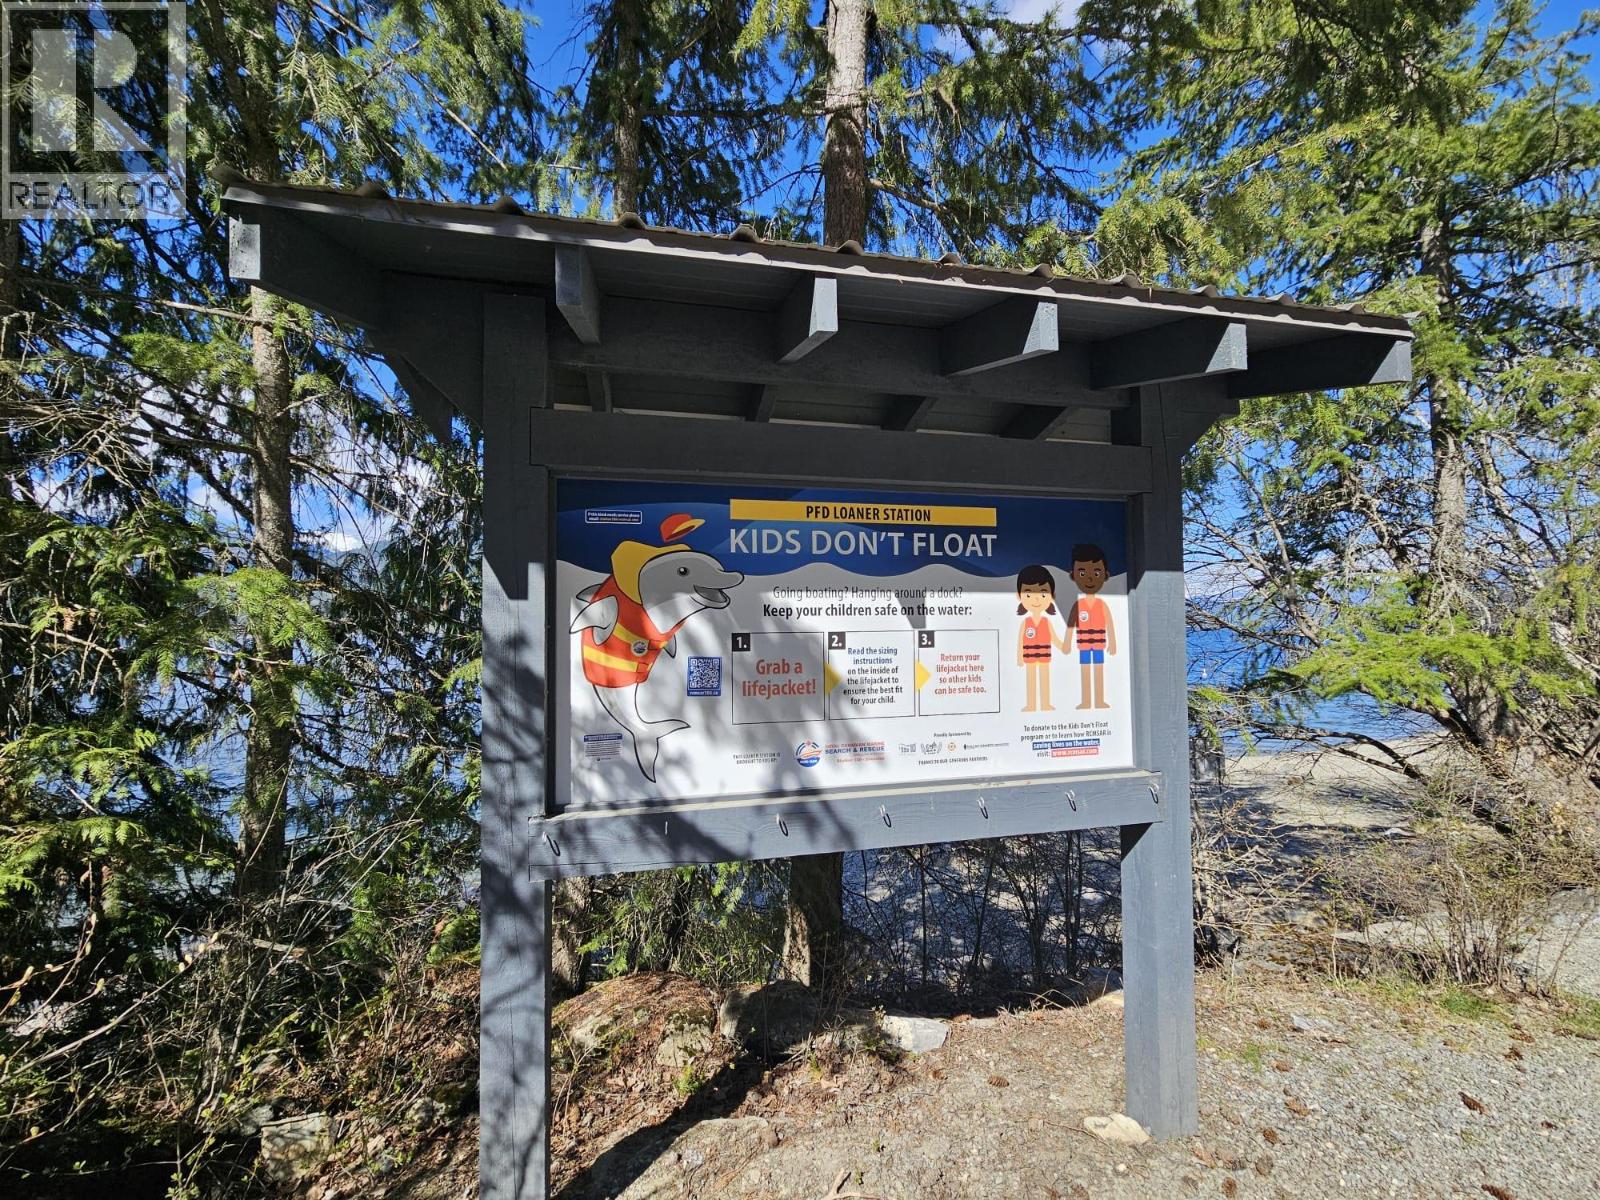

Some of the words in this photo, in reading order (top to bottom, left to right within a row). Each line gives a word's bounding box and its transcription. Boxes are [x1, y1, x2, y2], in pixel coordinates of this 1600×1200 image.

[806, 505, 830, 519] PFD
[833, 506, 880, 520] LOANER
[883, 508, 931, 522] STATION
[730, 528, 801, 554] KIDS
[811, 530, 905, 556] DON'T
[913, 532, 997, 557] FLOAT
[773, 586, 803, 601] Going
[805, 586, 848, 600] boating?
[851, 586, 892, 601] Hanging
[895, 586, 927, 599] around
[929, 590, 935, 599] a
[937, 586, 963, 599] dock?
[763, 604, 793, 620] Keep
[796, 607, 822, 619] your
[825, 604, 872, 617] children
[874, 604, 898, 616] safe
[900, 606, 915, 616] on
[917, 604, 934, 616] the
[936, 605, 972, 616] water:
[736, 637, 747, 649] 1.
[831, 635, 843, 647] 2.
[921, 633, 932, 645] 3.
[866, 647, 877, 655] the
[878, 647, 898, 656] sizing
[853, 657, 892, 665] instructions
[941, 653, 964, 662] Return
[965, 654, 980, 662] your
[756, 659, 790, 675] Grab
[794, 662, 803, 674] a
[891, 666, 898, 674] of
[936, 664, 967, 673] lifejacket
[968, 664, 984, 672] here
[847, 677, 859, 685] the
[860, 677, 890, 686] lifejacket
[948, 675, 966, 683] other
[968, 674, 982, 682] kids
[742, 678, 816, 700] lifejacket!
[867, 687, 878, 695] the
[880, 686, 894, 694] best
[958, 686, 972, 694] safe
[850, 697, 860, 705] for
[862, 698, 876, 706] your
[878, 696, 895, 704] child.
